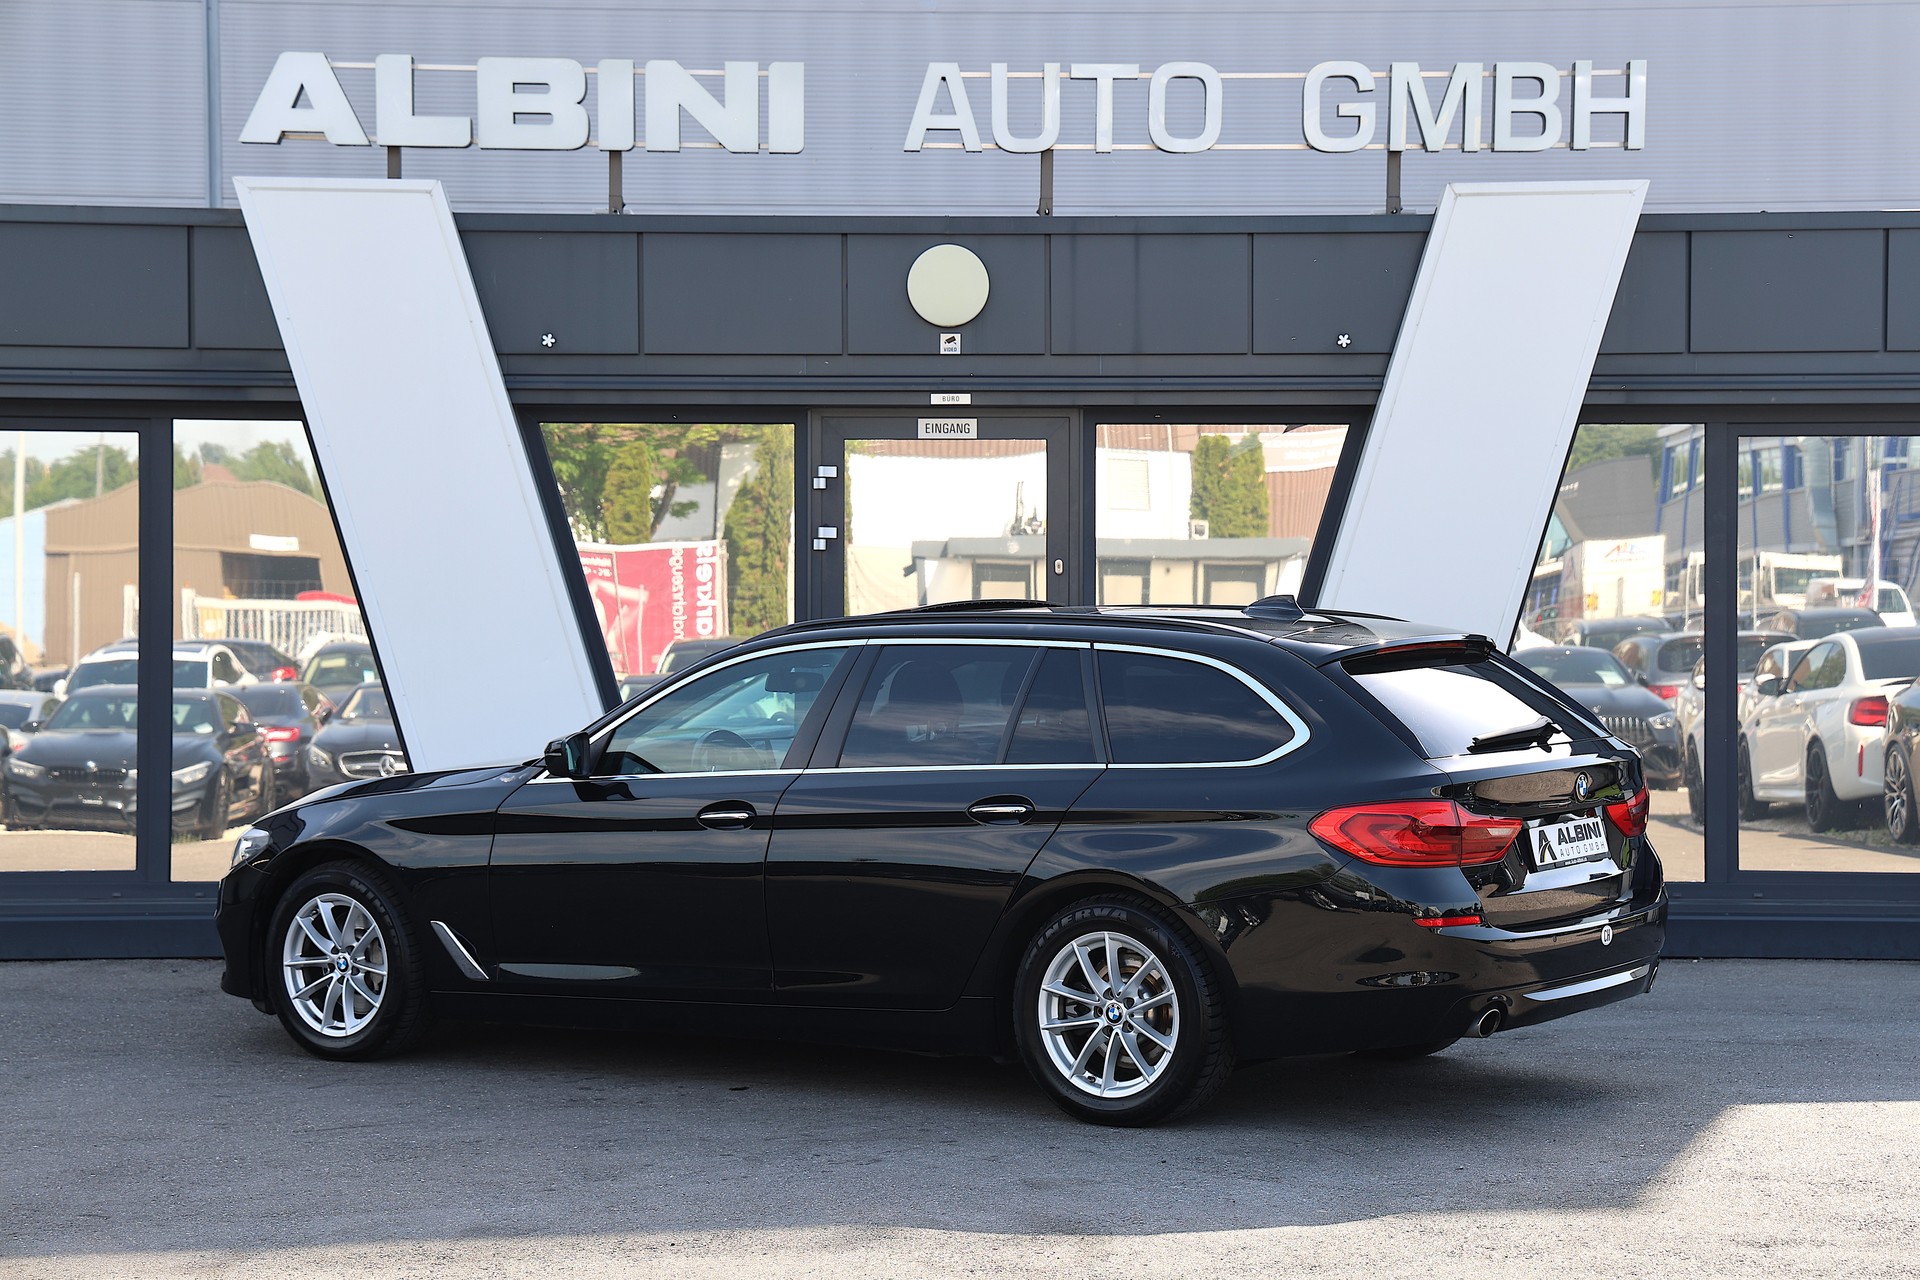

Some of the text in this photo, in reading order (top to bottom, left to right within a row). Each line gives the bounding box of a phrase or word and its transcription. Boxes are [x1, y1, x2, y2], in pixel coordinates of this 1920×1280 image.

[239, 51, 1648, 154] ALBINI AUTO GMBH
[925, 423, 971, 434] EINGANG
[1557, 821, 1602, 846] ALBINI
[1559, 841, 1606, 857] AUTO GMBH
[349, 878, 402, 958] MINER
[1603, 928, 1611, 942] CH
